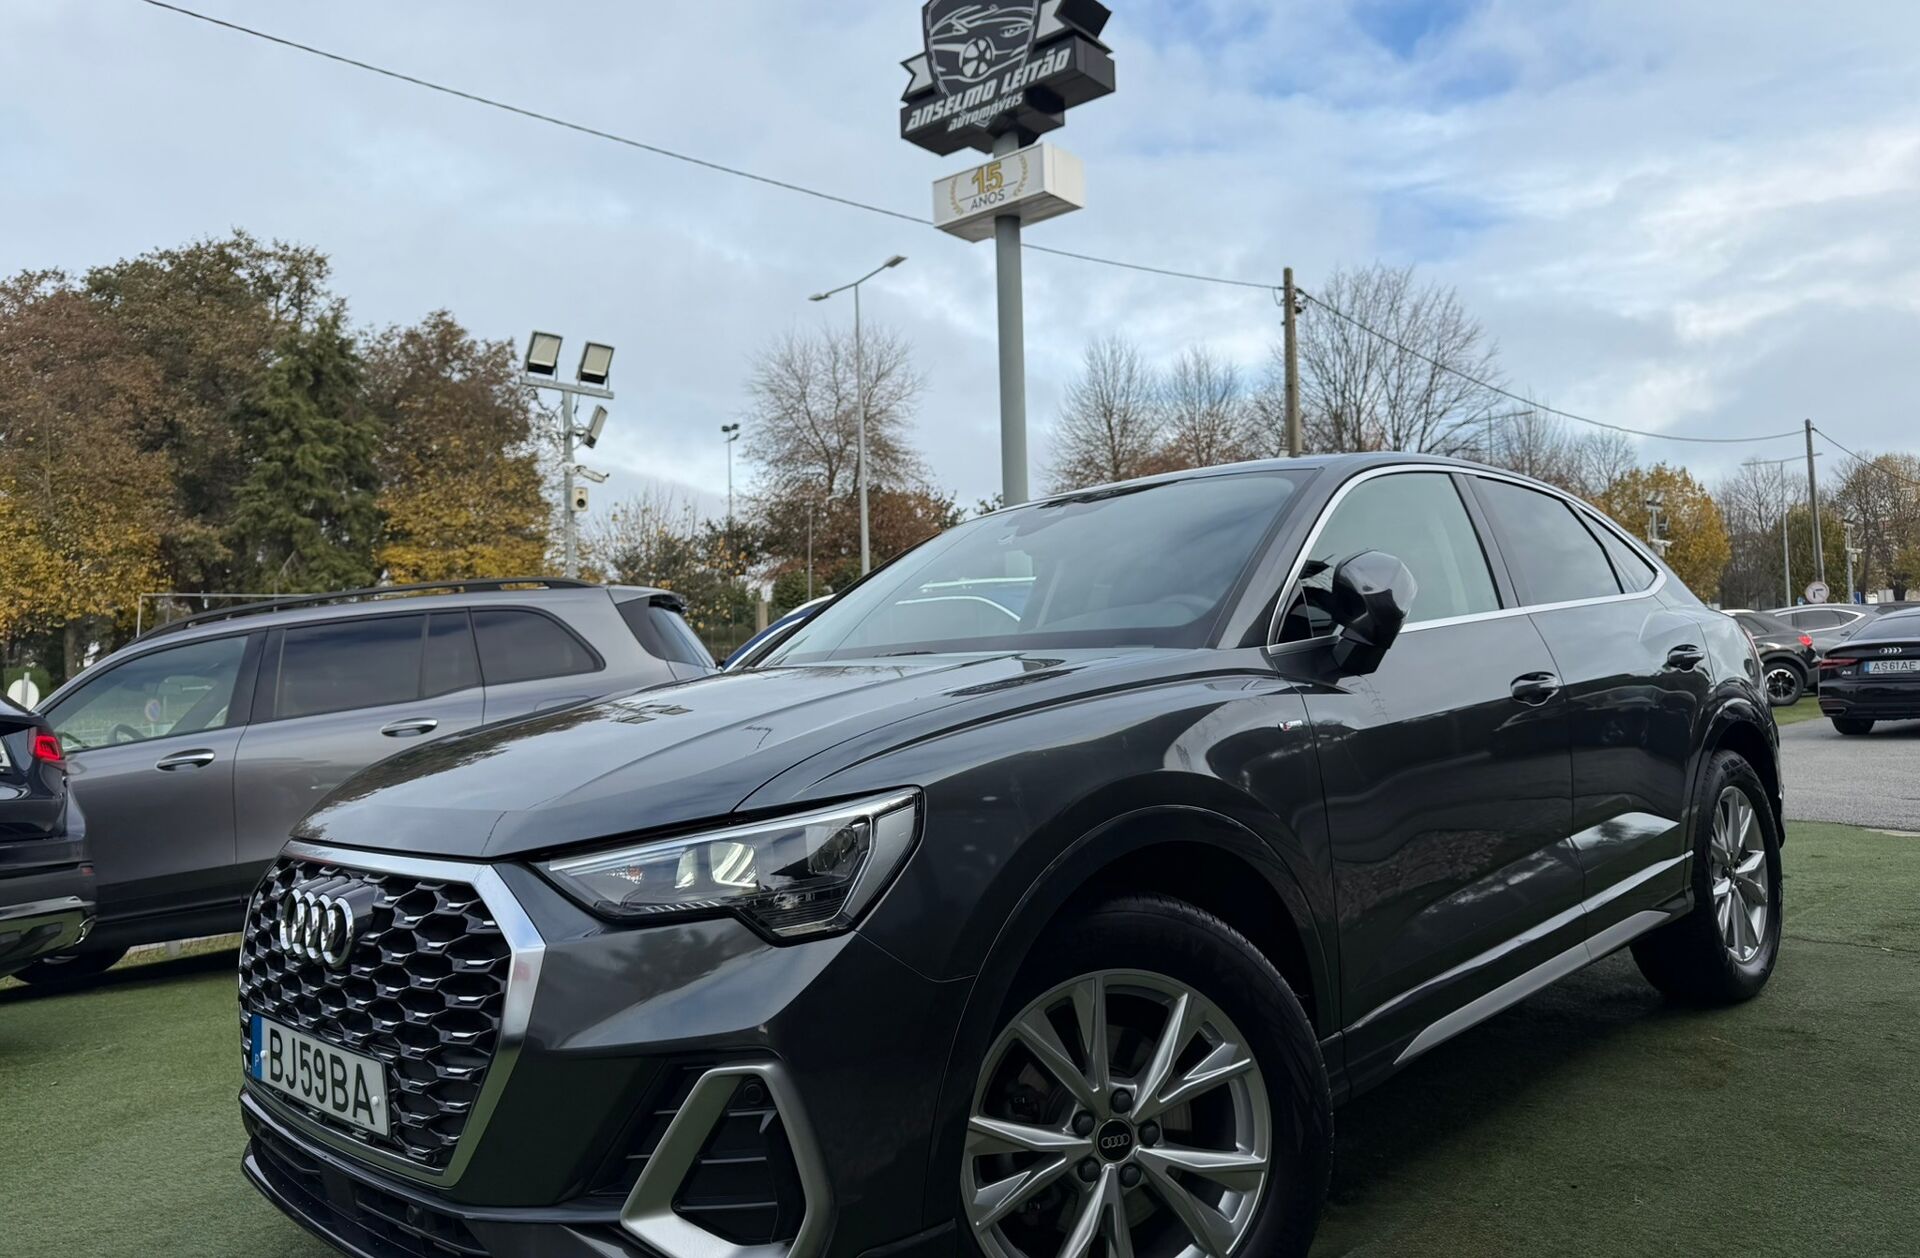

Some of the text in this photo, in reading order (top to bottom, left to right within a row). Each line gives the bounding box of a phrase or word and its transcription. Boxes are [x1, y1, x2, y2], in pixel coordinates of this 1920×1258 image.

[971, 161, 1004, 194] 15
[970, 188, 1006, 211] ANOS
[1873, 661, 1917, 671] AS61AE
[254, 1053, 260, 1067] P
[269, 1027, 376, 1126] BJ59BA
